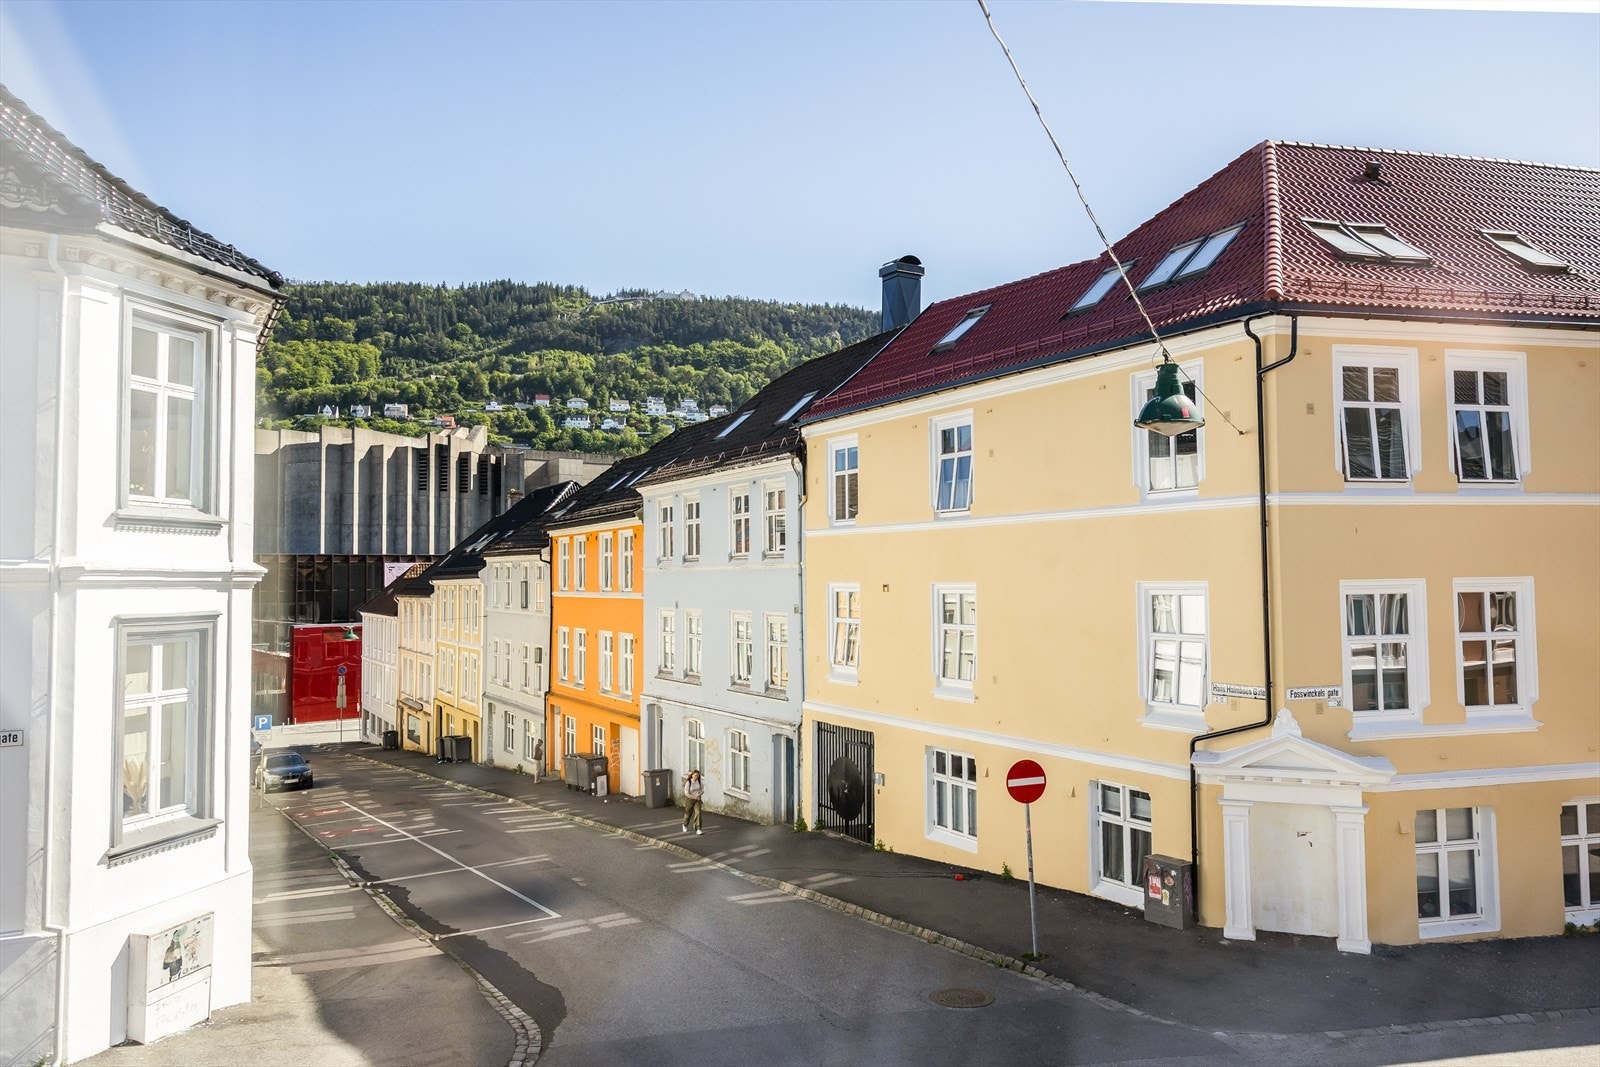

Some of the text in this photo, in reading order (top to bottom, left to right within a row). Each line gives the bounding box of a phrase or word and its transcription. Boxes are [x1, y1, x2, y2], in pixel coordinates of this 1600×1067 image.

[1290, 688, 1339, 699] Fosswinckels gate
[258, 717, 268, 729] P
[0, 733, 18, 745] ate
